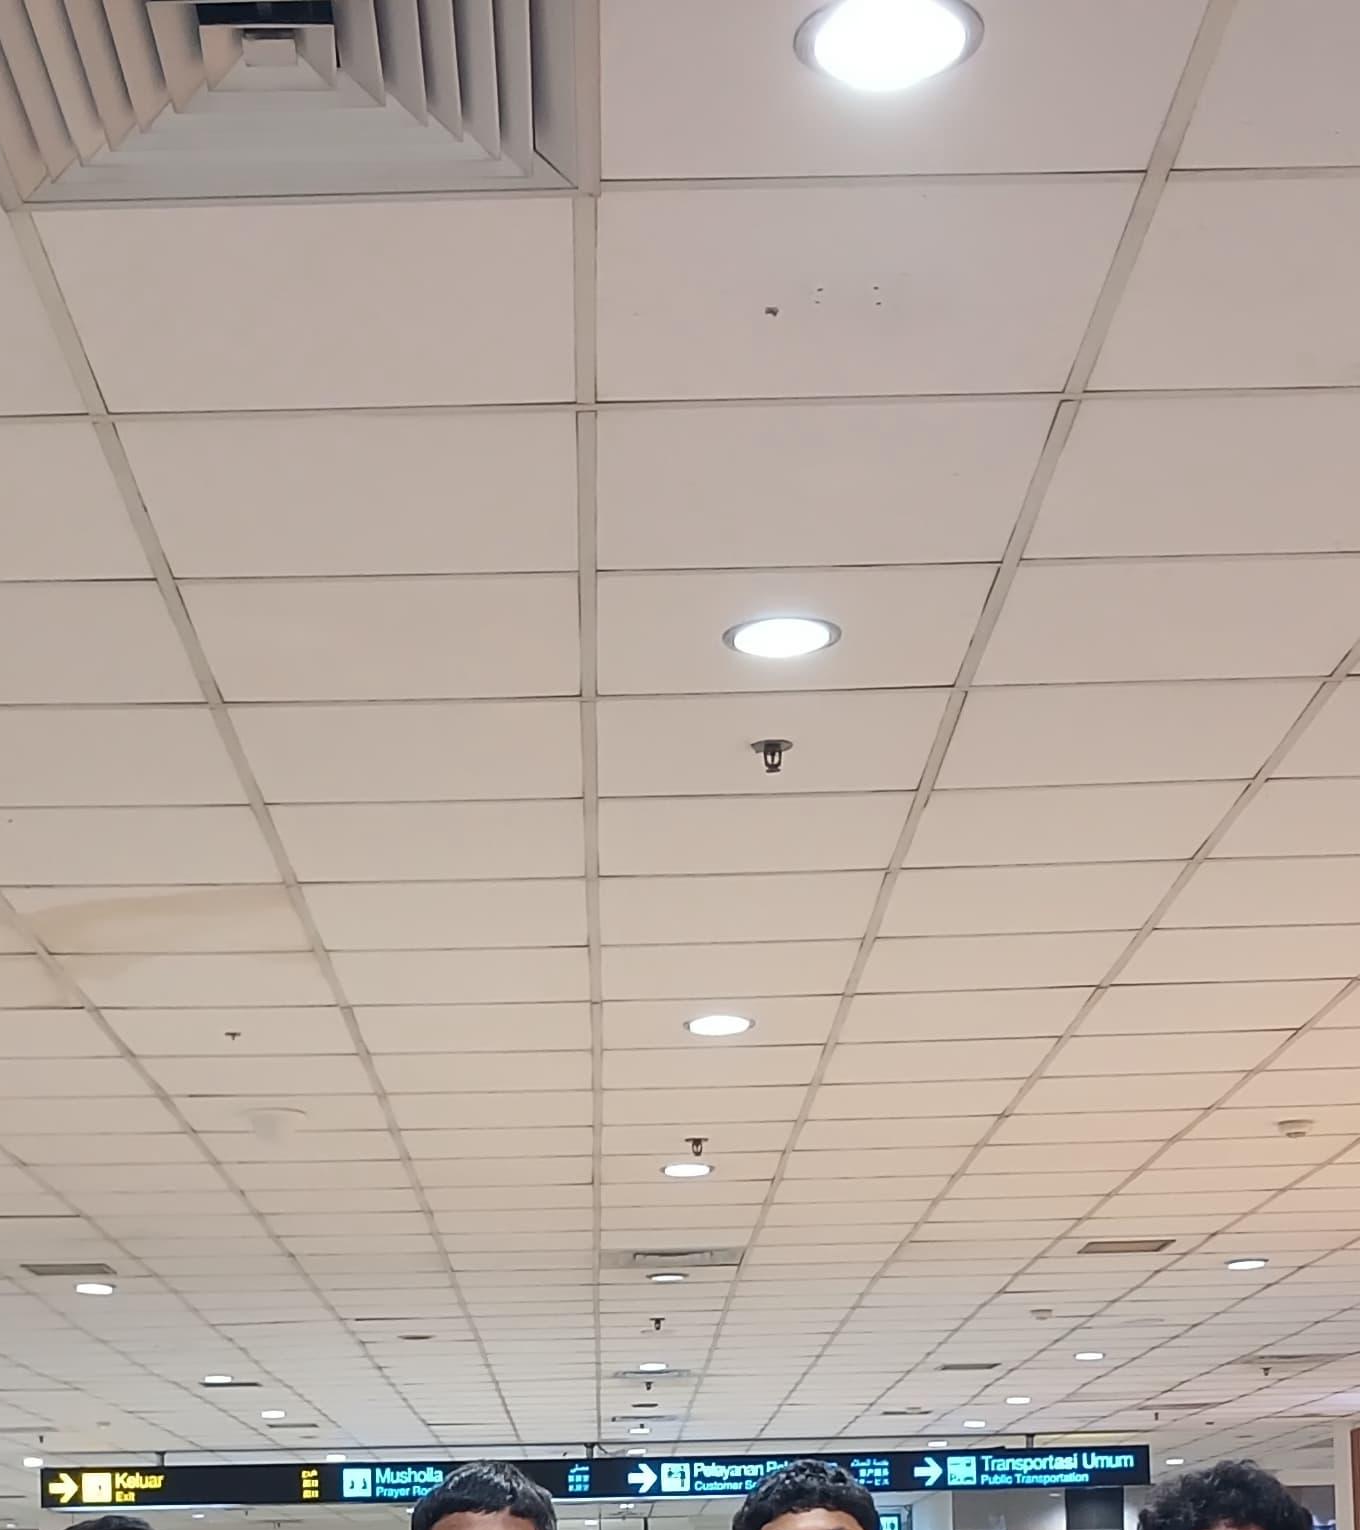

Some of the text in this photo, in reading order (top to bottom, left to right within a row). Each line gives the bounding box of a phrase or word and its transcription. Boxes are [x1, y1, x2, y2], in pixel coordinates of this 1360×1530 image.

[693, 1460, 764, 1481] Pelayanan
[981, 1452, 1135, 1474] Transportasi Umum
[115, 1472, 165, 1490] Keluar
[375, 1466, 444, 1484] Musholla
[980, 1471, 1090, 1485] Public Transportation
[375, 1485, 435, 1499] Prayer Roo
[693, 1480, 742, 1492] Customer
[115, 1491, 136, 1503] Exit
